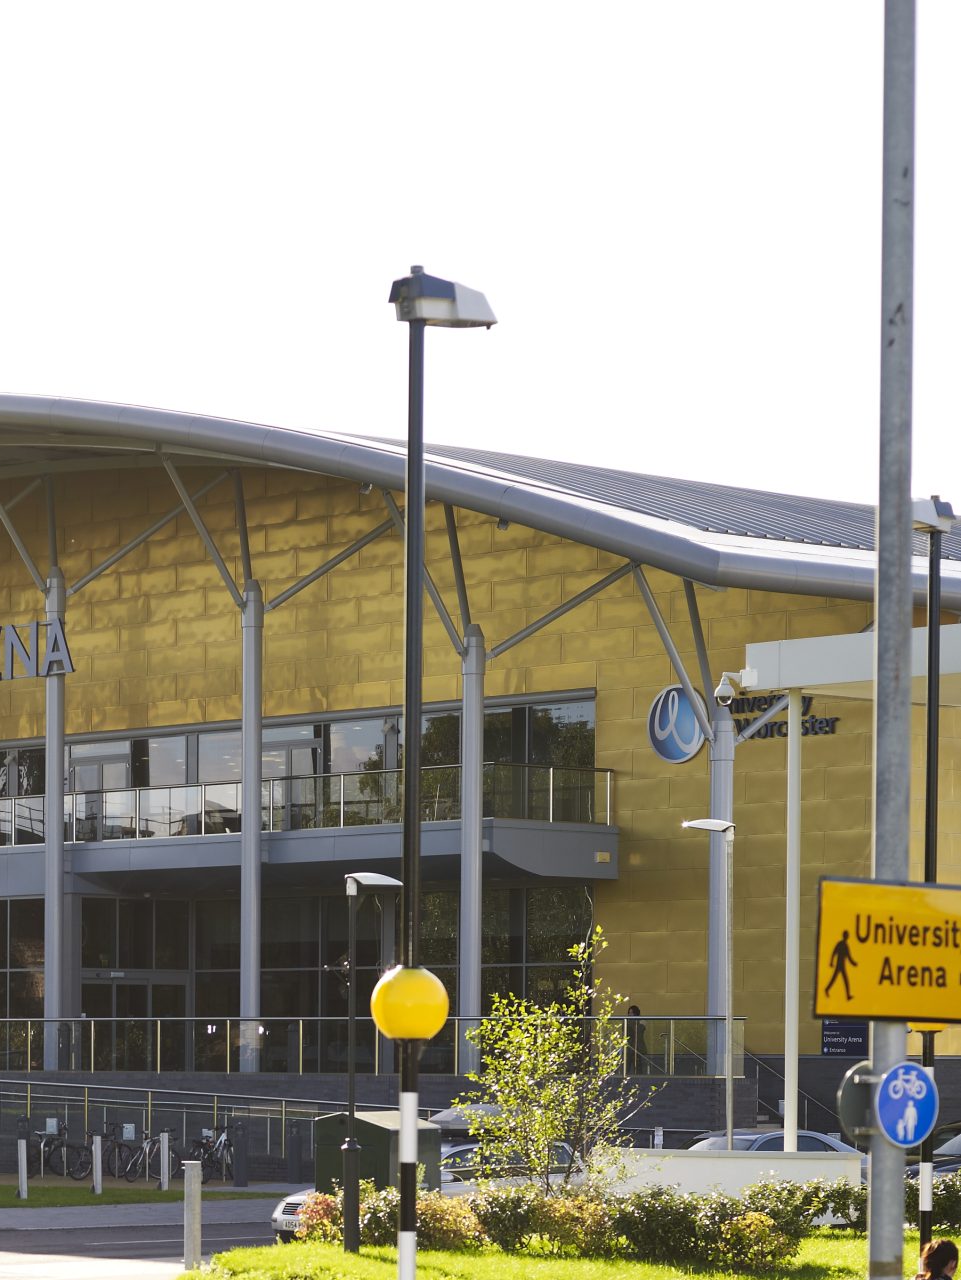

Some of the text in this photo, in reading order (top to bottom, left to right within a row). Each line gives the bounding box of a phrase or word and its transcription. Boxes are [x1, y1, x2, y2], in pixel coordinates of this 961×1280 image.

[733, 714, 840, 739] Worcster
[856, 914, 961, 949] Universit
[878, 956, 948, 988] Arena
